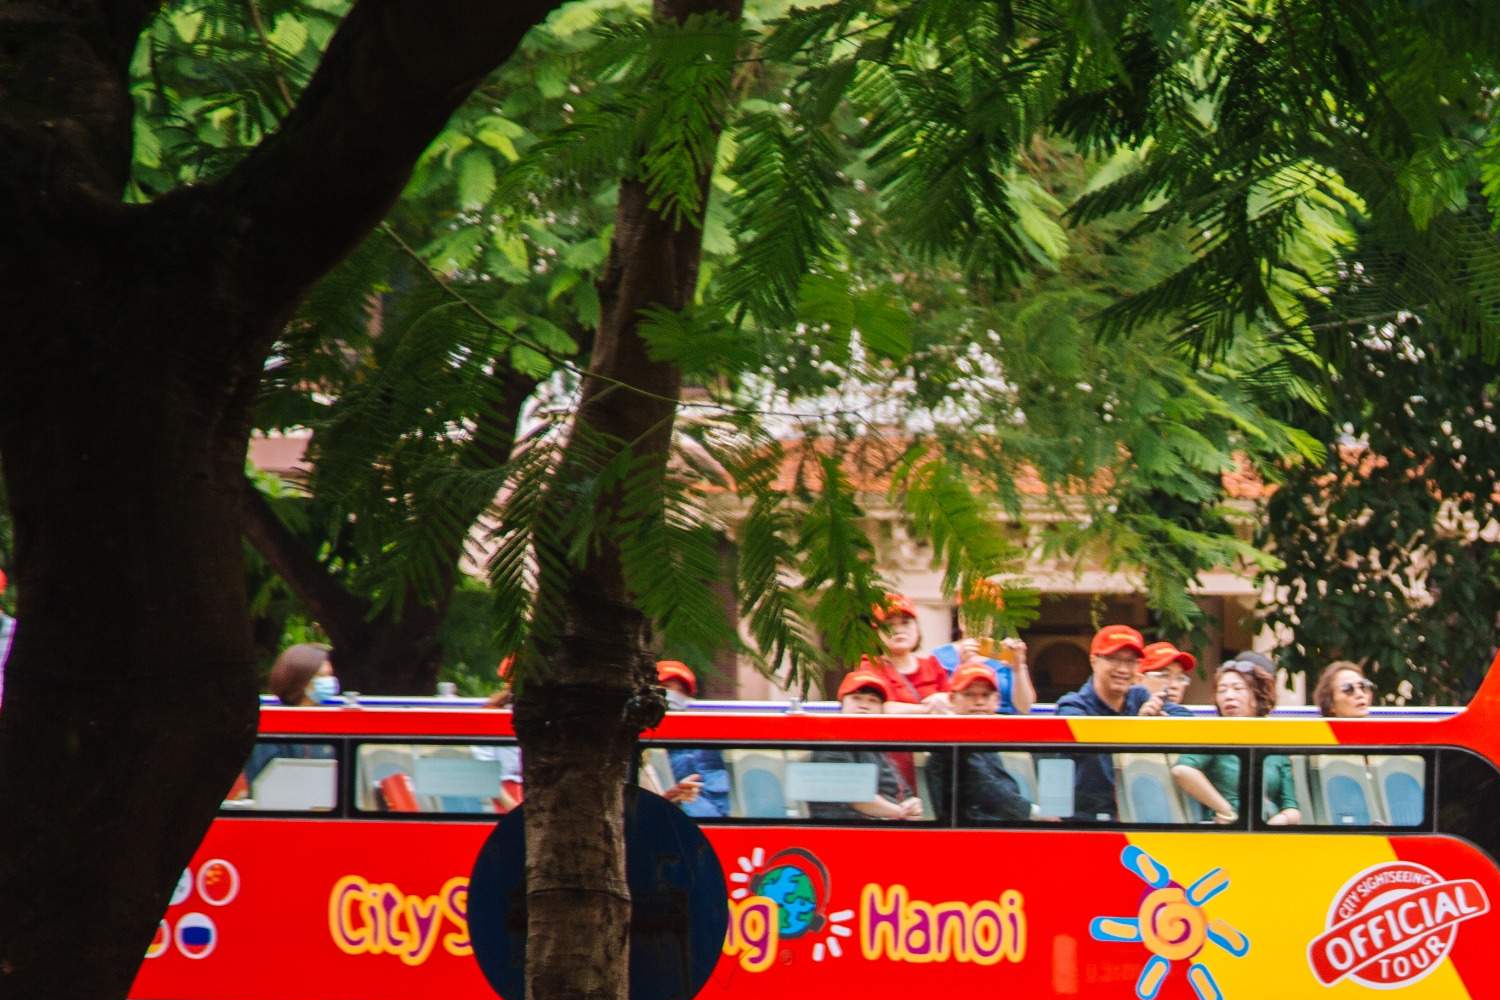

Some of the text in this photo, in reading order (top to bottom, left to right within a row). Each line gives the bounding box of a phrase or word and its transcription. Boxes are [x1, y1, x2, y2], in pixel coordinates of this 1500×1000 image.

[861, 883, 1027, 965] Hanoi
[1338, 870, 1432, 919] CITY SIGHTSEEING
[1325, 887, 1478, 971] OFFICIAL
[1378, 935, 1448, 979] TOUR
